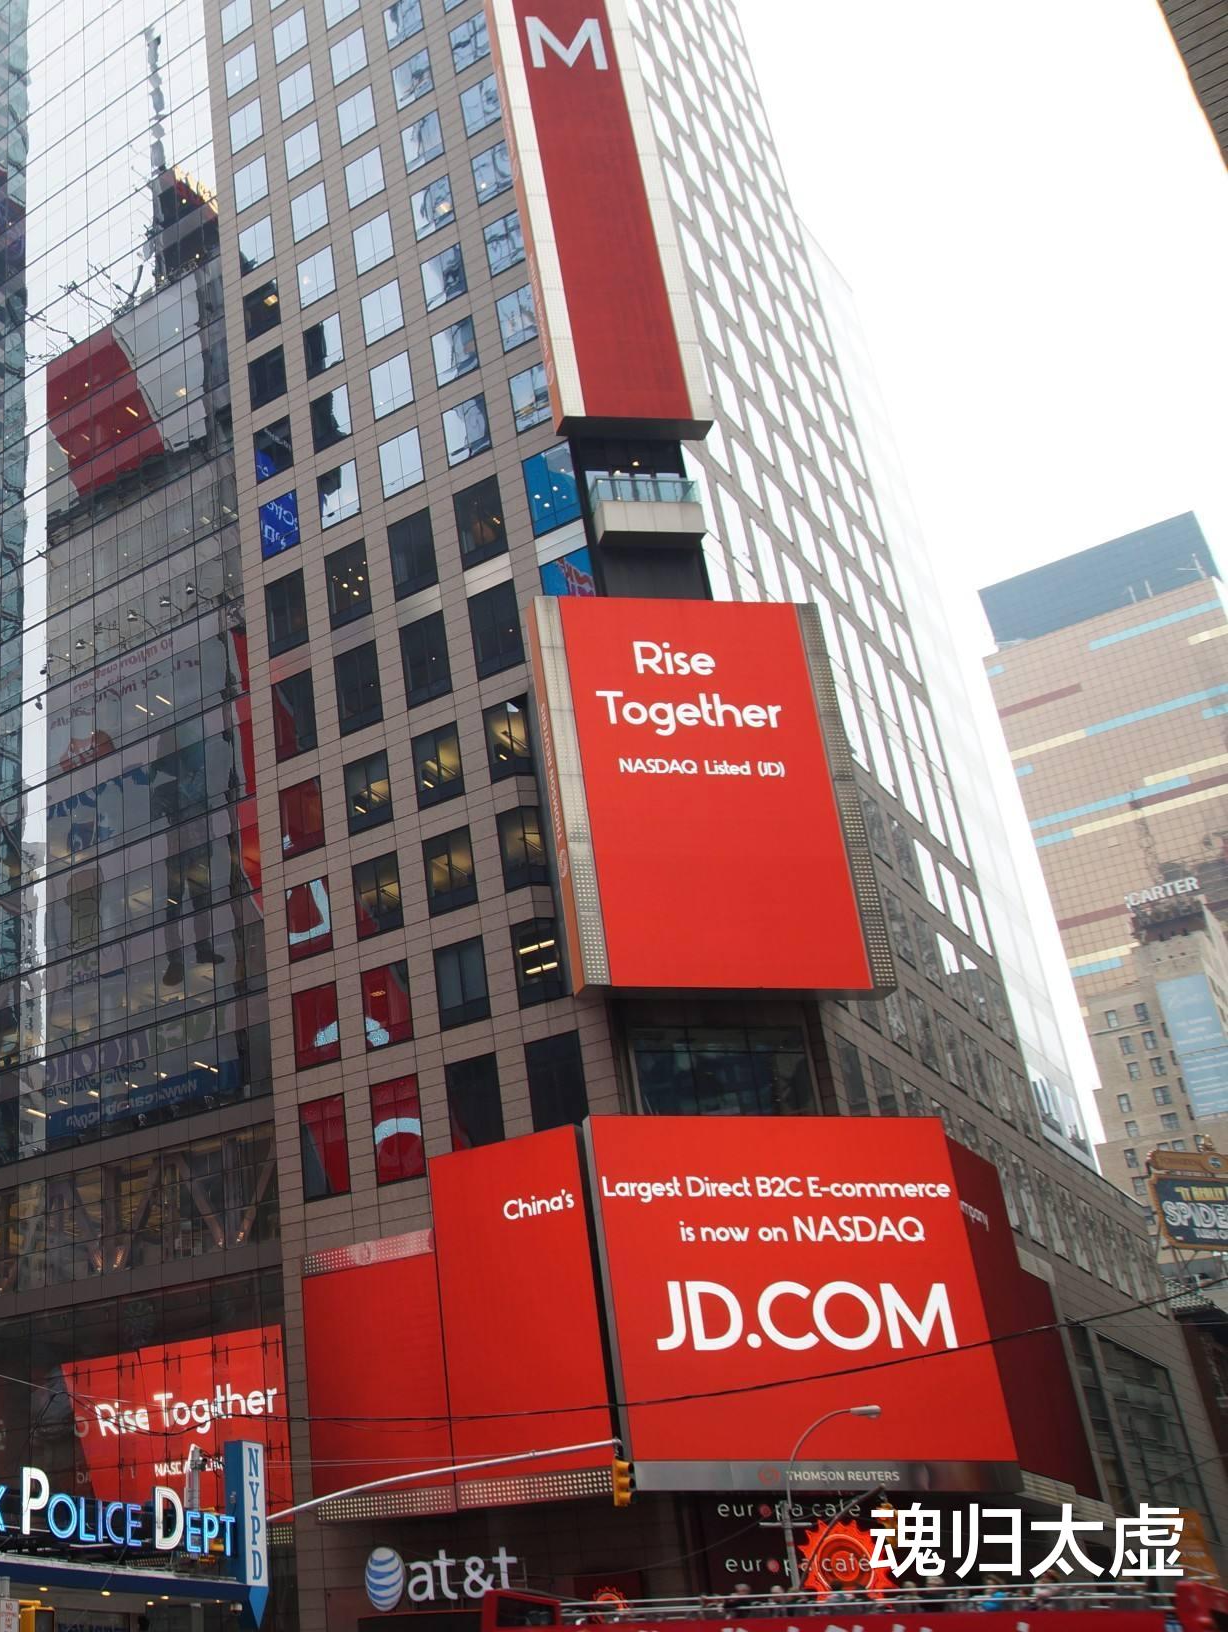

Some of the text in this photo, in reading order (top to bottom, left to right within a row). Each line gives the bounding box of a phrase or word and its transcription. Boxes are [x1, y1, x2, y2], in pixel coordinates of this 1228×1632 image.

[525, 16, 608, 70] M
[633, 641, 716, 676] Rise
[595, 691, 782, 736] Together
[540, 703, 563, 840] THOMSON REUTERS
[618, 757, 786, 777] NASDAQ Listed (JD)
[1128, 876, 1200, 907] CARTER
[503, 1189, 575, 1220] China's
[601, 1176, 681, 1203] Largest
[686, 1177, 752, 1198] Direct
[757, 1177, 803, 1198] B2C
[808, 1177, 951, 1198] E-commerce
[680, 1215, 926, 1243] is now on NASDAQ
[656, 1280, 958, 1351] JD.COM
[94, 1383, 278, 1437] Rise Together
[788, 1471, 900, 1481] THOMSON REUTERS
[21, 1466, 143, 1547] POLICE
[153, 1485, 237, 1557] DEPT
[247, 1447, 264, 1581] NYPD
[407, 1546, 517, 1602] at&t
